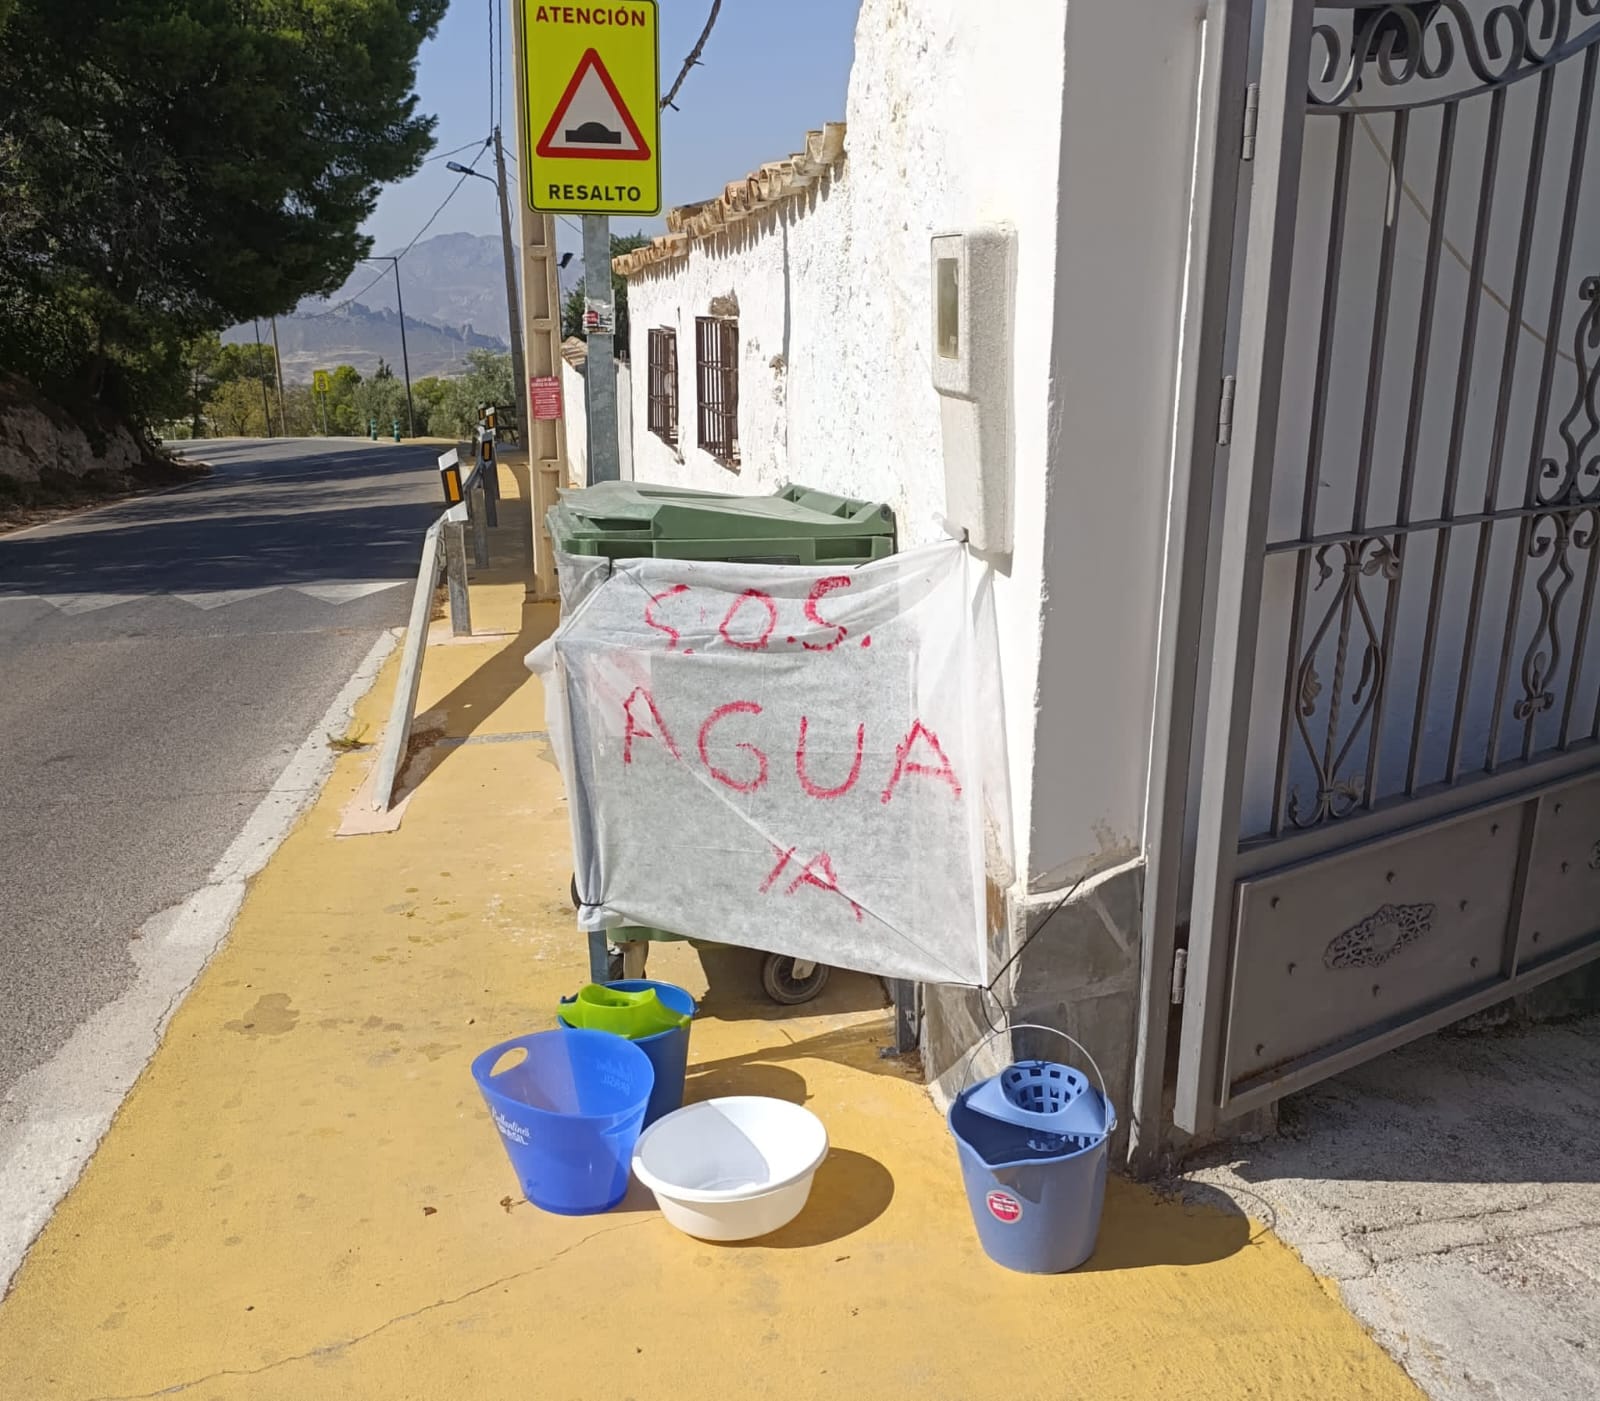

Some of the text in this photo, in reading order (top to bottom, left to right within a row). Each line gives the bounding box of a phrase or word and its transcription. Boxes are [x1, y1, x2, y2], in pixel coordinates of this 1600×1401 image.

[535, 6, 646, 27] ATENCIÓN
[549, 184, 641, 201] RESALTO
[645, 575, 872, 655] S.O.S.
[622, 686, 963, 804] AGUA
[758, 839, 863, 923] YA
